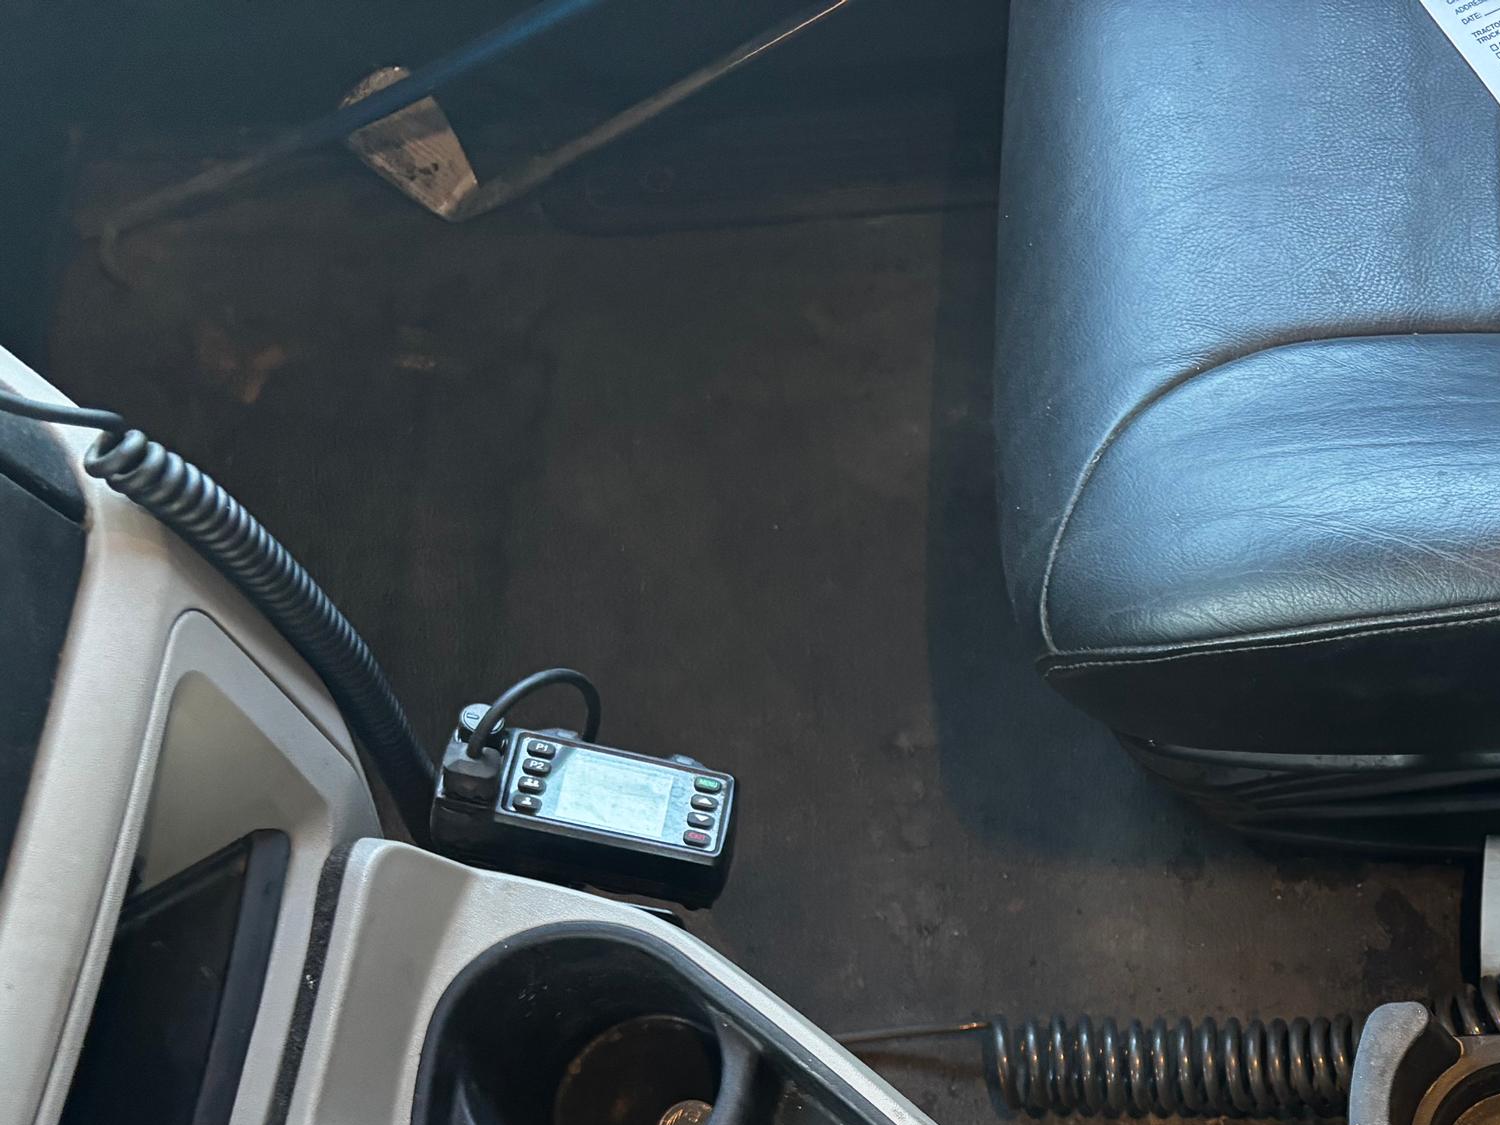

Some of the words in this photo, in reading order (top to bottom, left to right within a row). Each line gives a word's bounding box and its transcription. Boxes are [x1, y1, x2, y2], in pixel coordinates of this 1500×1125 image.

[1461, 12, 1482, 25] DATE:
[535, 742, 549, 752] P1
[529, 759, 545, 770] P2
